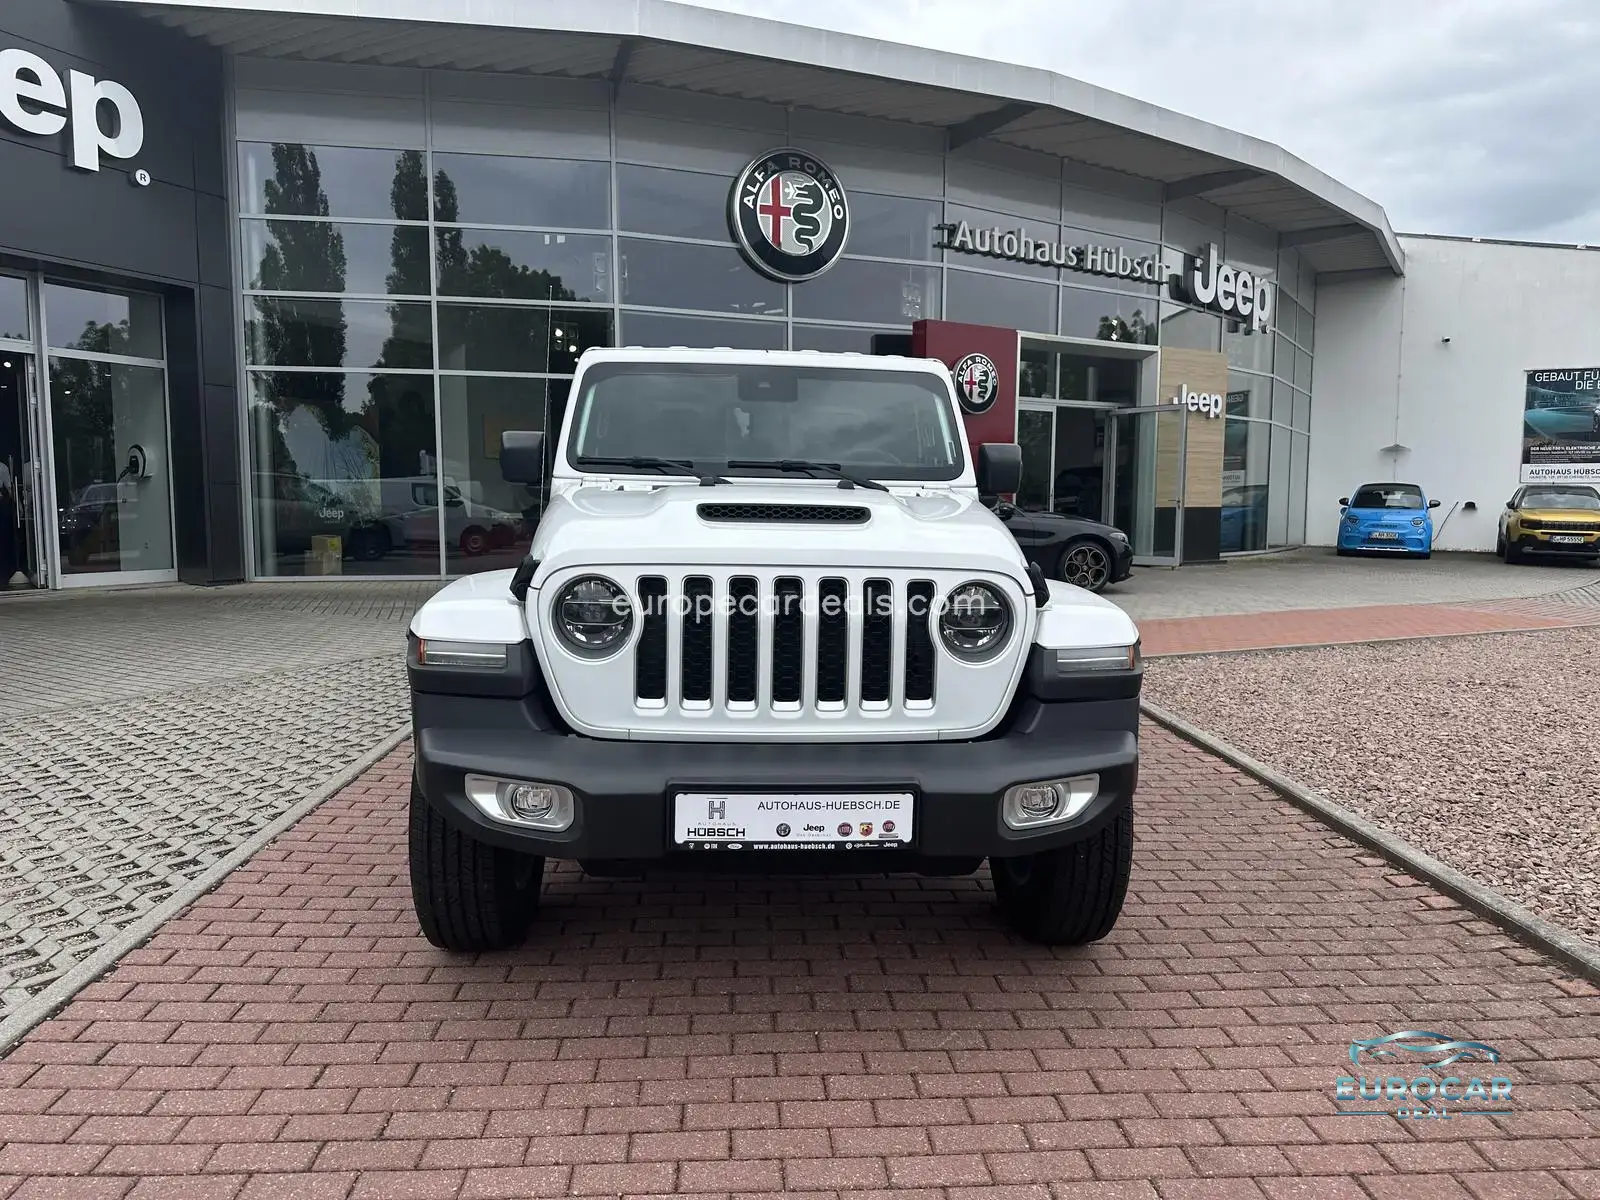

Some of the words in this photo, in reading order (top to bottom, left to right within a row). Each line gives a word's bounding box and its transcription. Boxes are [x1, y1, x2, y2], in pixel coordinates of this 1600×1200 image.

[743, 160, 780, 209] ALFA
[788, 156, 844, 220] ROMEO
[953, 220, 1078, 266] Autohaus
[1086, 243, 1169, 282] Hübsch
[1193, 242, 1271, 331] Jeep
[957, 359, 973, 383] ALFA
[975, 356, 998, 386] ROMEO
[1534, 371, 1582, 382] GEBAUT
[1575, 380, 1594, 390] DIE
[1173, 383, 1223, 418] Jeep
[1529, 468, 1572, 476] AUTOHAUS
[319, 507, 344, 520] Jeep
[757, 800, 900, 811] AUTOHAUS-HUEBSCH.DE
[687, 827, 746, 837] HÜBSCH
[803, 823, 825, 833] Jeep
[753, 842, 836, 850] www.autohaus-huebsch.de
